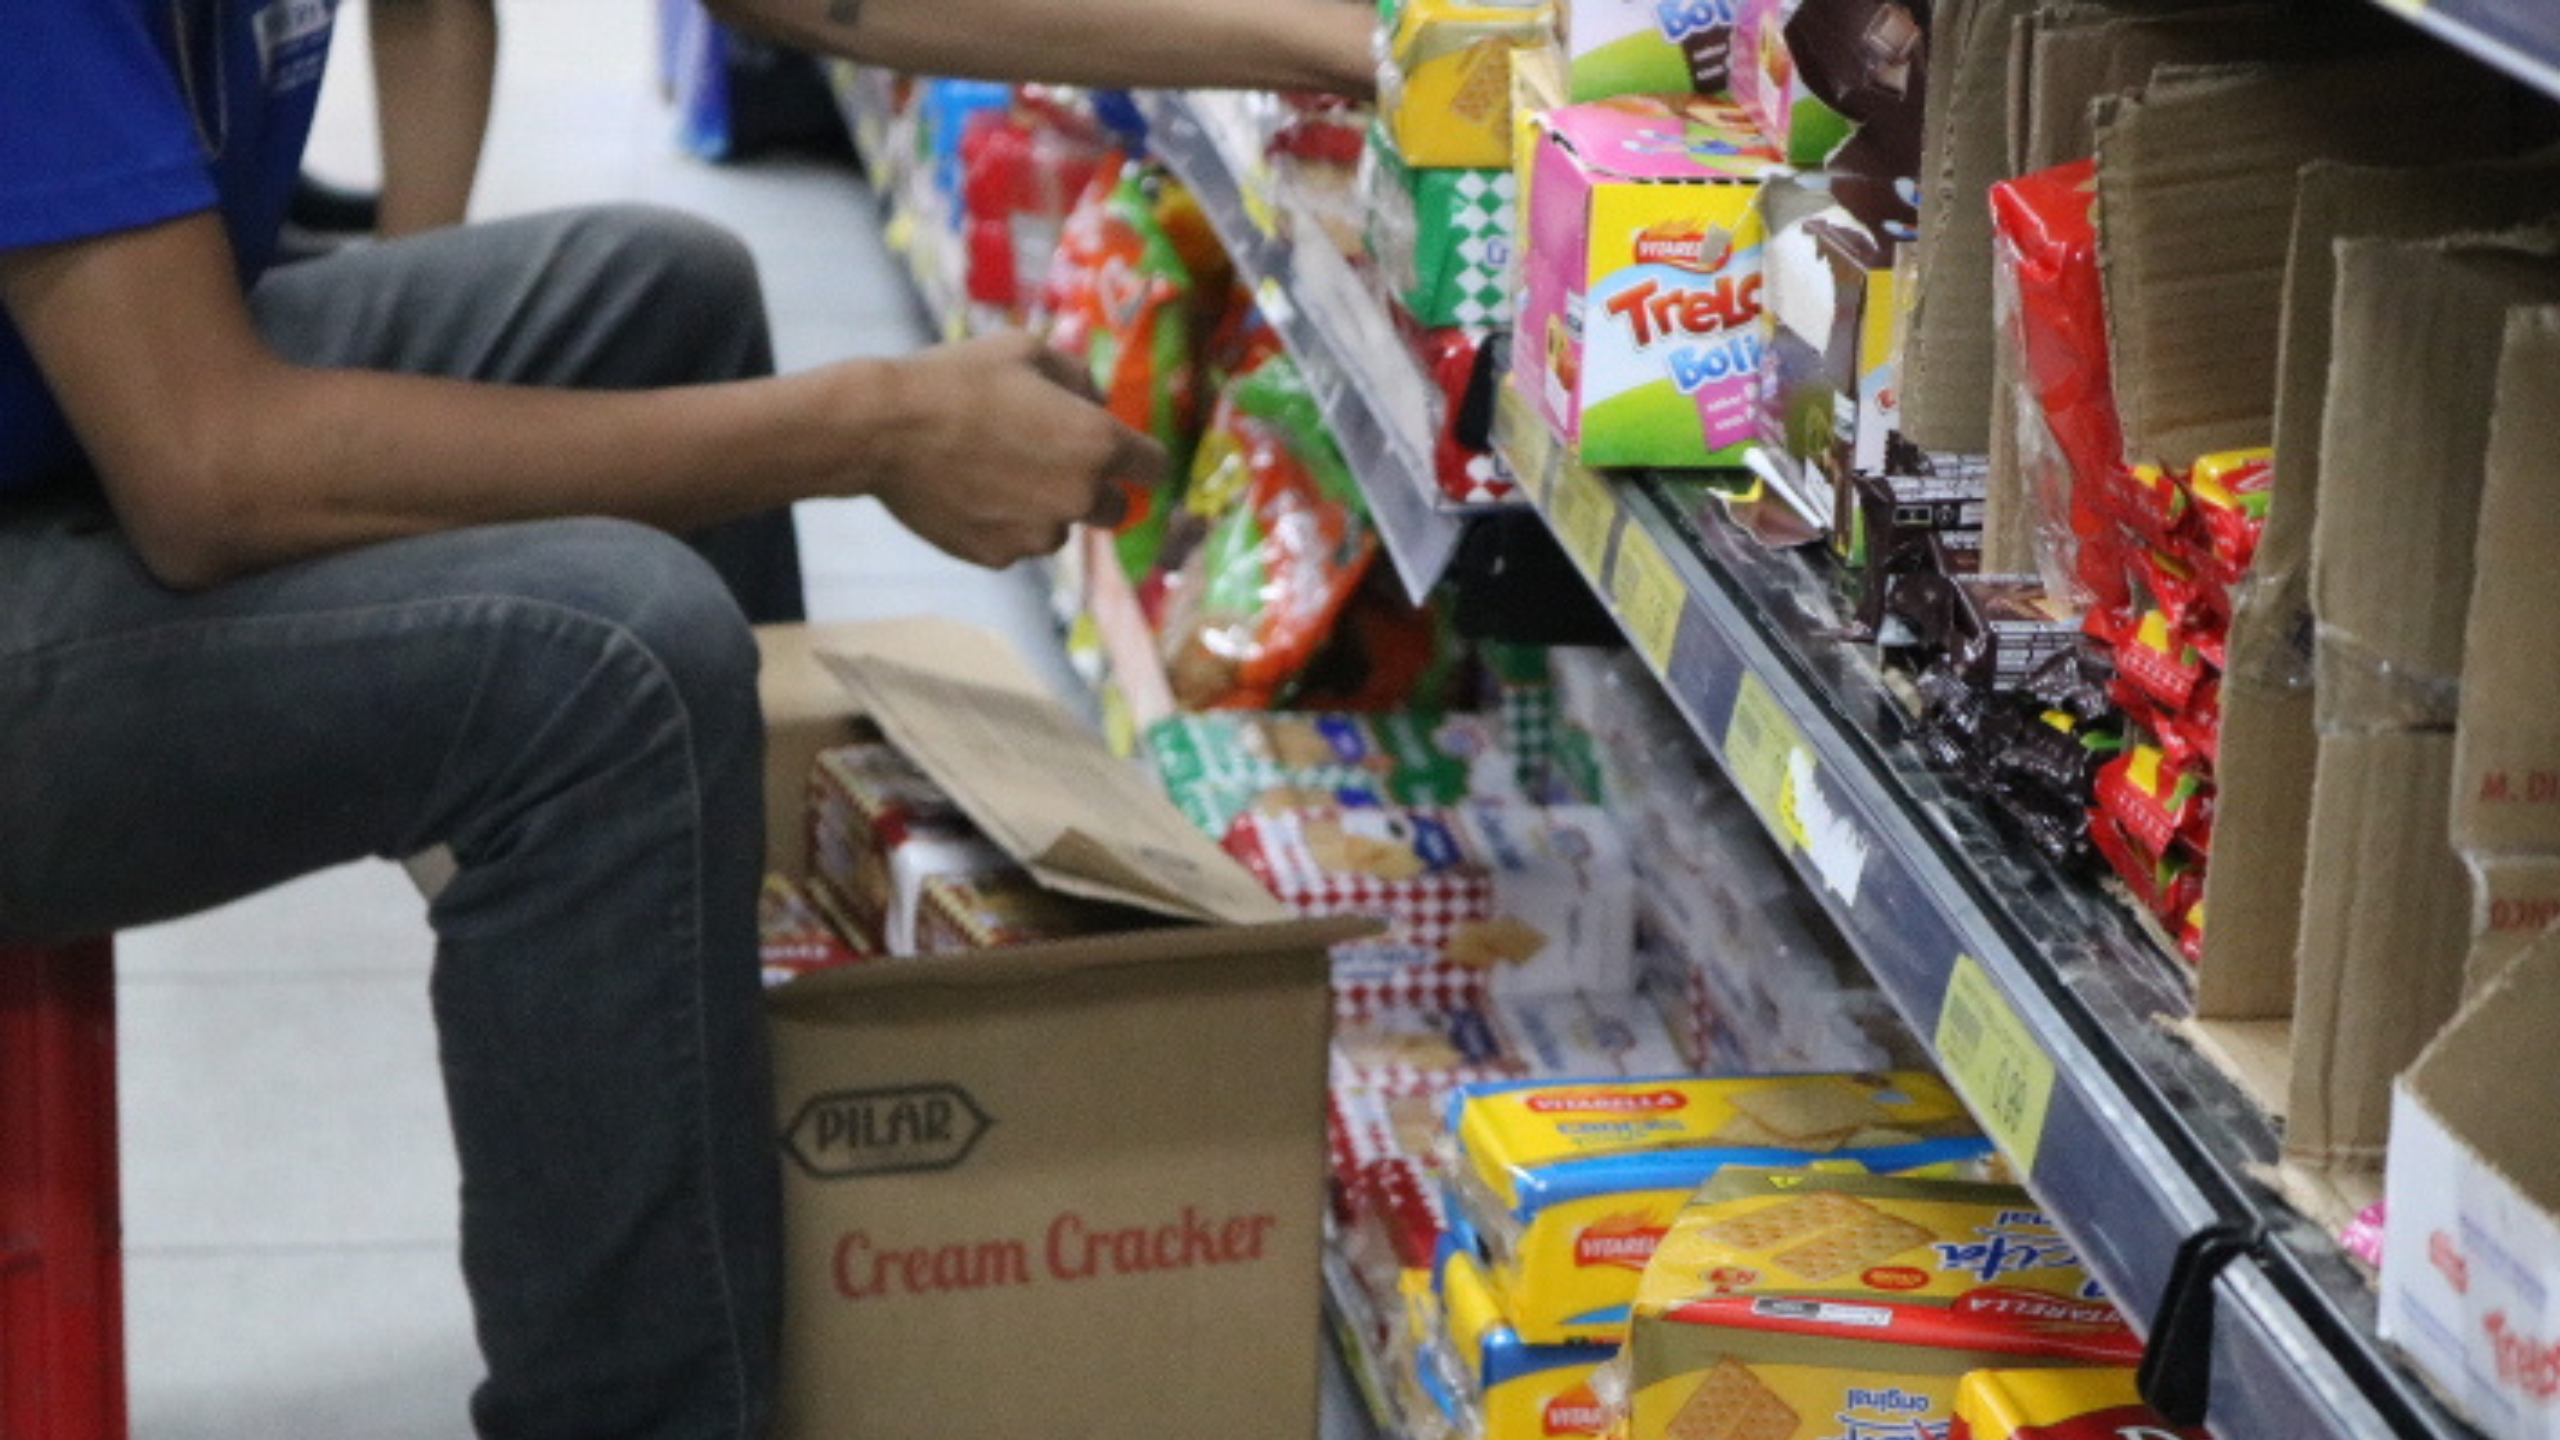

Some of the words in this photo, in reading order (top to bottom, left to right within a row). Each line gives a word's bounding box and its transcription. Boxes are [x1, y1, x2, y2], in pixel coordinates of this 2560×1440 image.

[1668, 335, 1762, 390] Boli
[816, 1101, 953, 1150] PILAR
[832, 1229, 1030, 1299] Cream
[1045, 1207, 1276, 1281] Cracker
